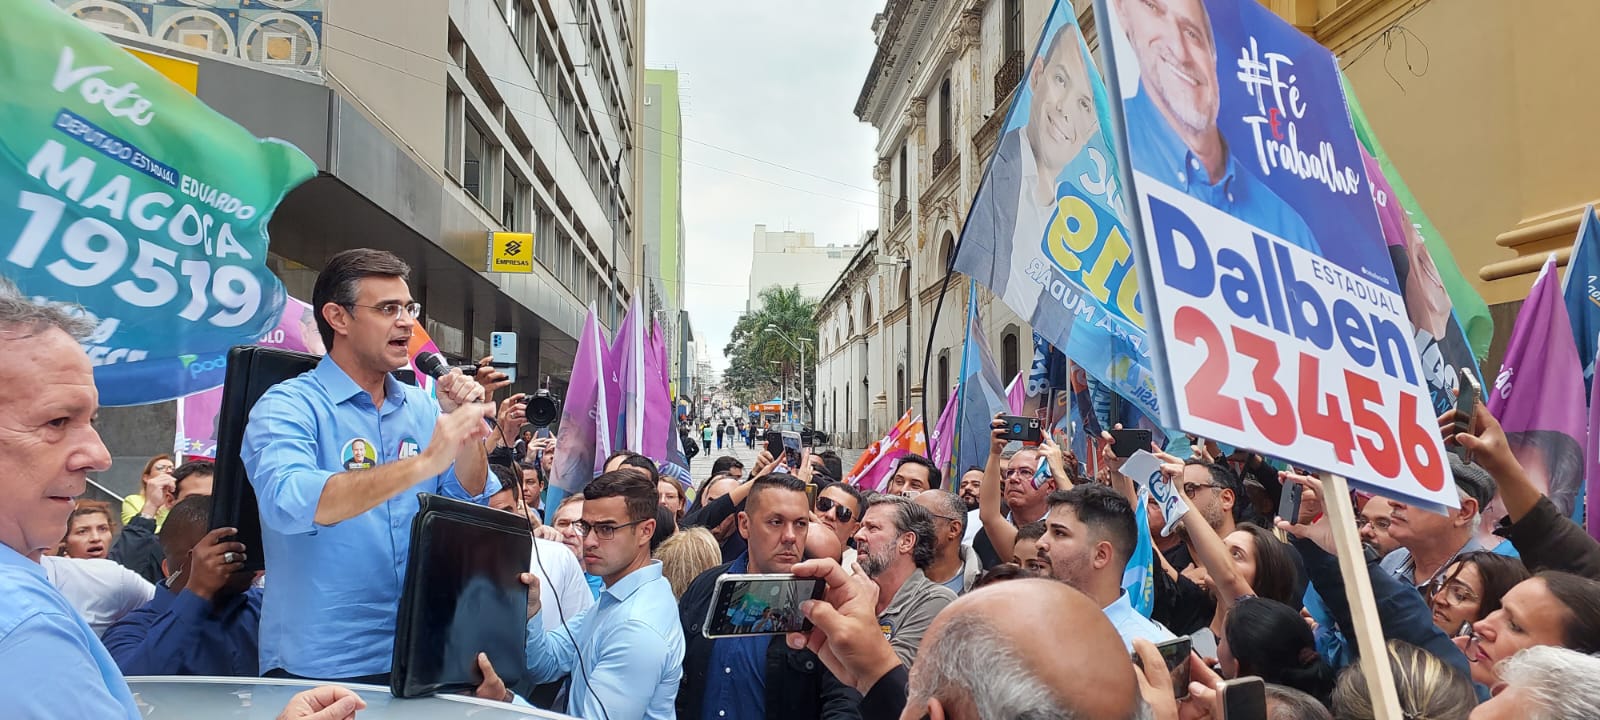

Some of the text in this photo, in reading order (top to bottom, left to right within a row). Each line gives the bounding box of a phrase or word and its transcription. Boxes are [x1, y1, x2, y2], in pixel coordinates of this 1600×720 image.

[52, 46, 155, 127] Vote
[56, 113, 176, 185] DEPUTADO ESTADUAL
[1242, 116, 1360, 195] Trabalho
[180, 174, 256, 220] EDUARDO
[6, 190, 262, 328] 19519
[496, 258, 529, 266] EMPRESAS
[1147, 194, 1419, 386] Dalben
[1311, 259, 1400, 315] ESTADUAL
[1174, 306, 1444, 492] 23456
[399, 441, 418, 460] 45
